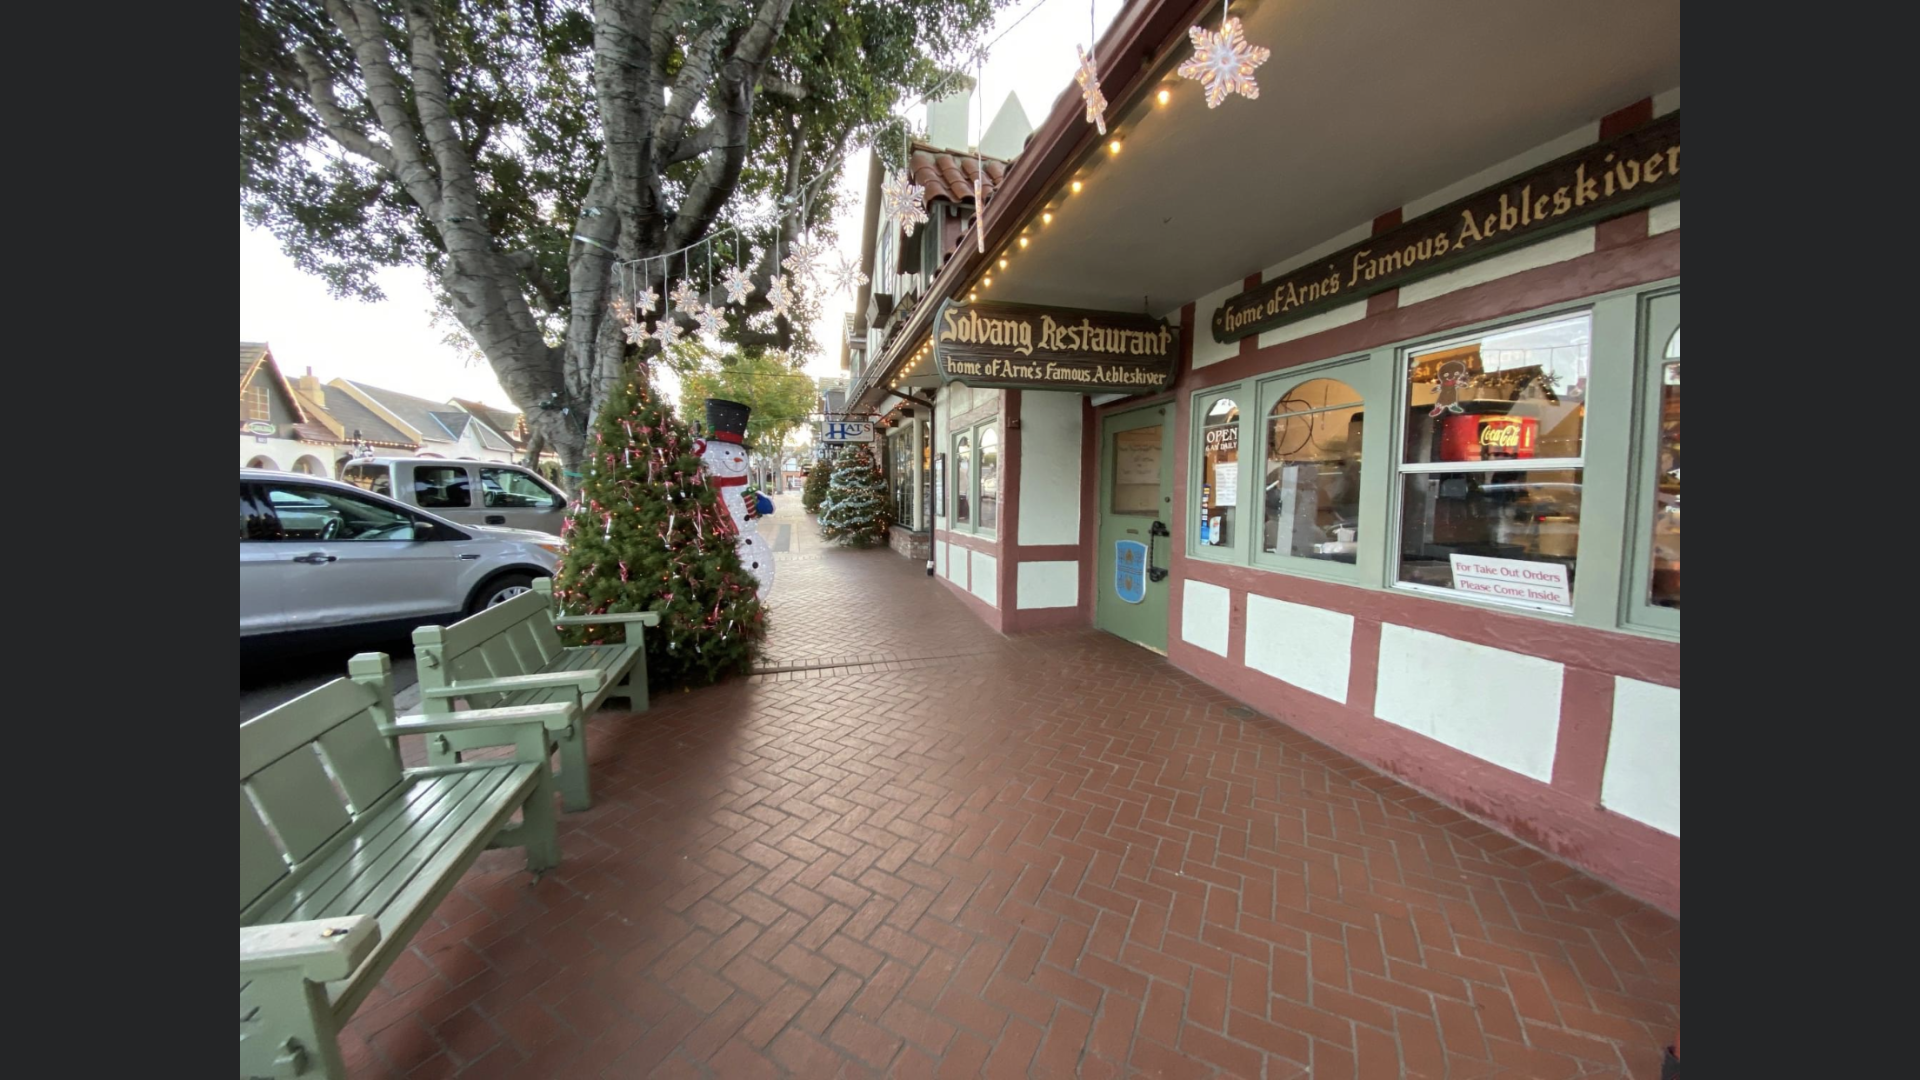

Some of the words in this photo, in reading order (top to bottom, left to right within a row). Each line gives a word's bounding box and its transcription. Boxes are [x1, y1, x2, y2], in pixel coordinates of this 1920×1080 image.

[1225, 303, 1263, 332] home
[1266, 284, 1285, 316] of
[1282, 264, 1341, 311] Arne's
[1347, 232, 1450, 287] Famous
[1452, 144, 1680, 250] Aebleskiver
[941, 308, 1033, 356] Solvang
[1038, 314, 1172, 356] Restaurant
[947, 356, 981, 376] home
[984, 359, 1002, 377] of
[1000, 359, 1042, 380] Arne's
[1044, 362, 1091, 383] Famous
[1091, 365, 1167, 386] Aebleskiver
[826, 422, 871, 440] HATS
[1206, 427, 1238, 443] OPEN
[1456, 562, 1471, 572] For
[1473, 563, 1498, 575] Take
[1500, 566, 1520, 577] Out
[1522, 569, 1561, 583] Orders
[1460, 579, 1491, 592] Please
[1493, 584, 1525, 597] Come
[1527, 588, 1561, 602] Inside
